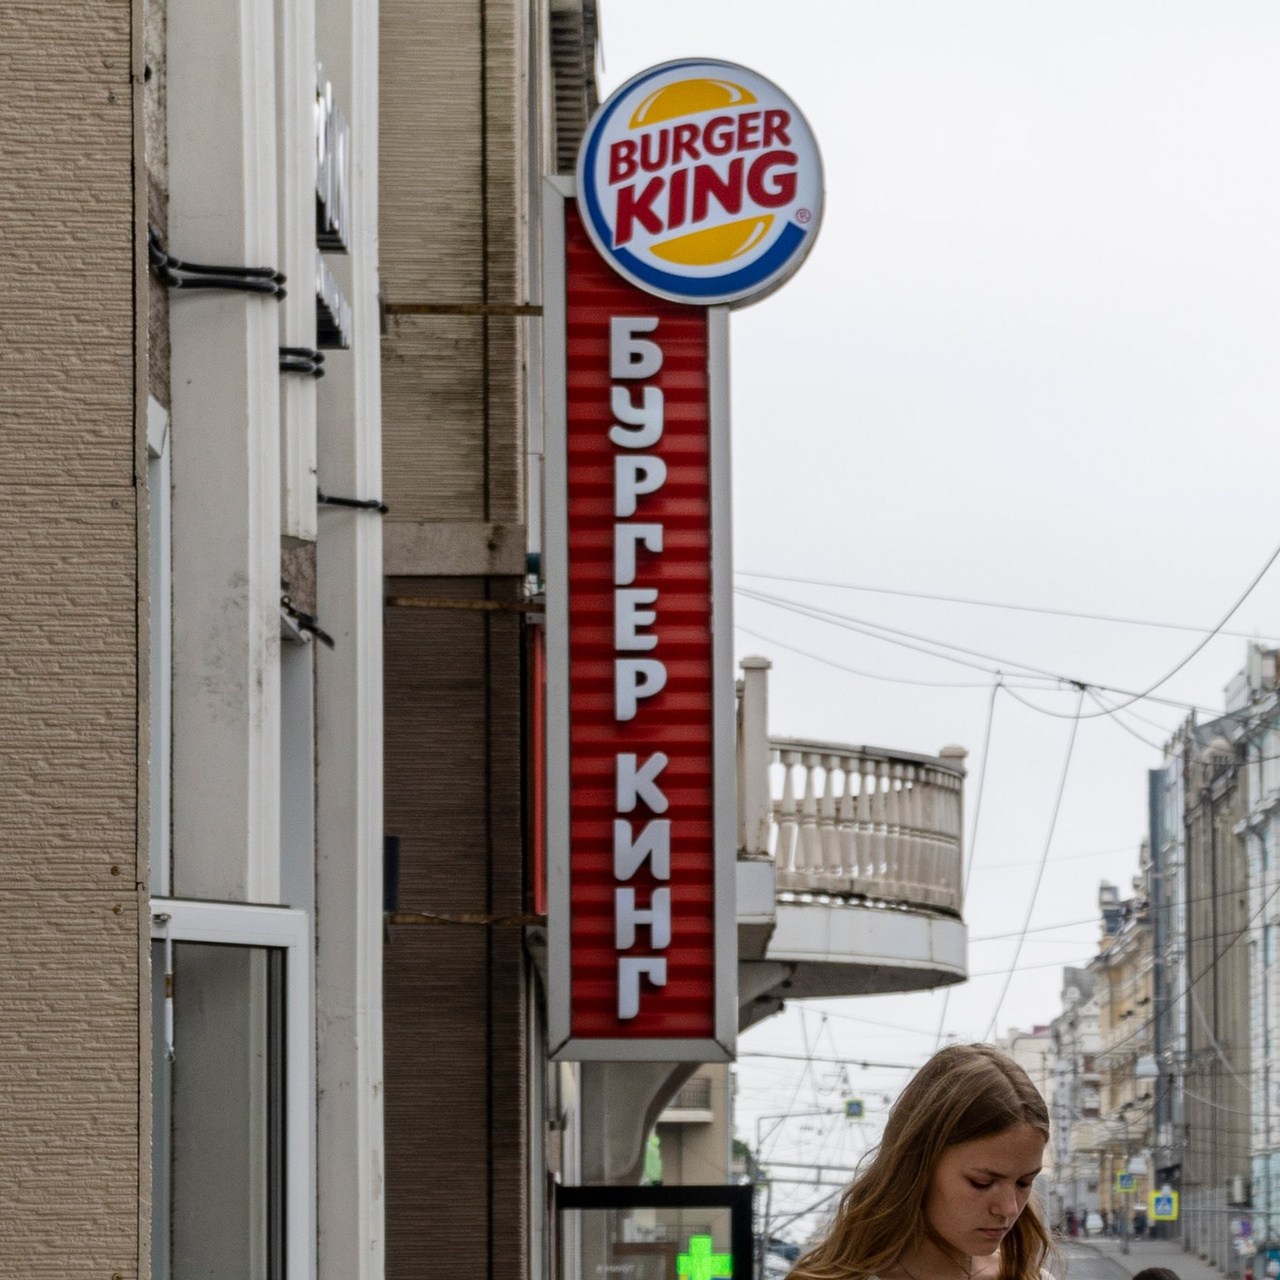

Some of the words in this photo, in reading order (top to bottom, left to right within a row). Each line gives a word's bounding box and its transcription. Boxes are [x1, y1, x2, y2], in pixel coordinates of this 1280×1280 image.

[608, 108, 792, 186] BURGER
[612, 150, 799, 249] KING
[608, 316, 669, 721] БУРГЕР
[612, 752, 672, 1020] КИНГ
